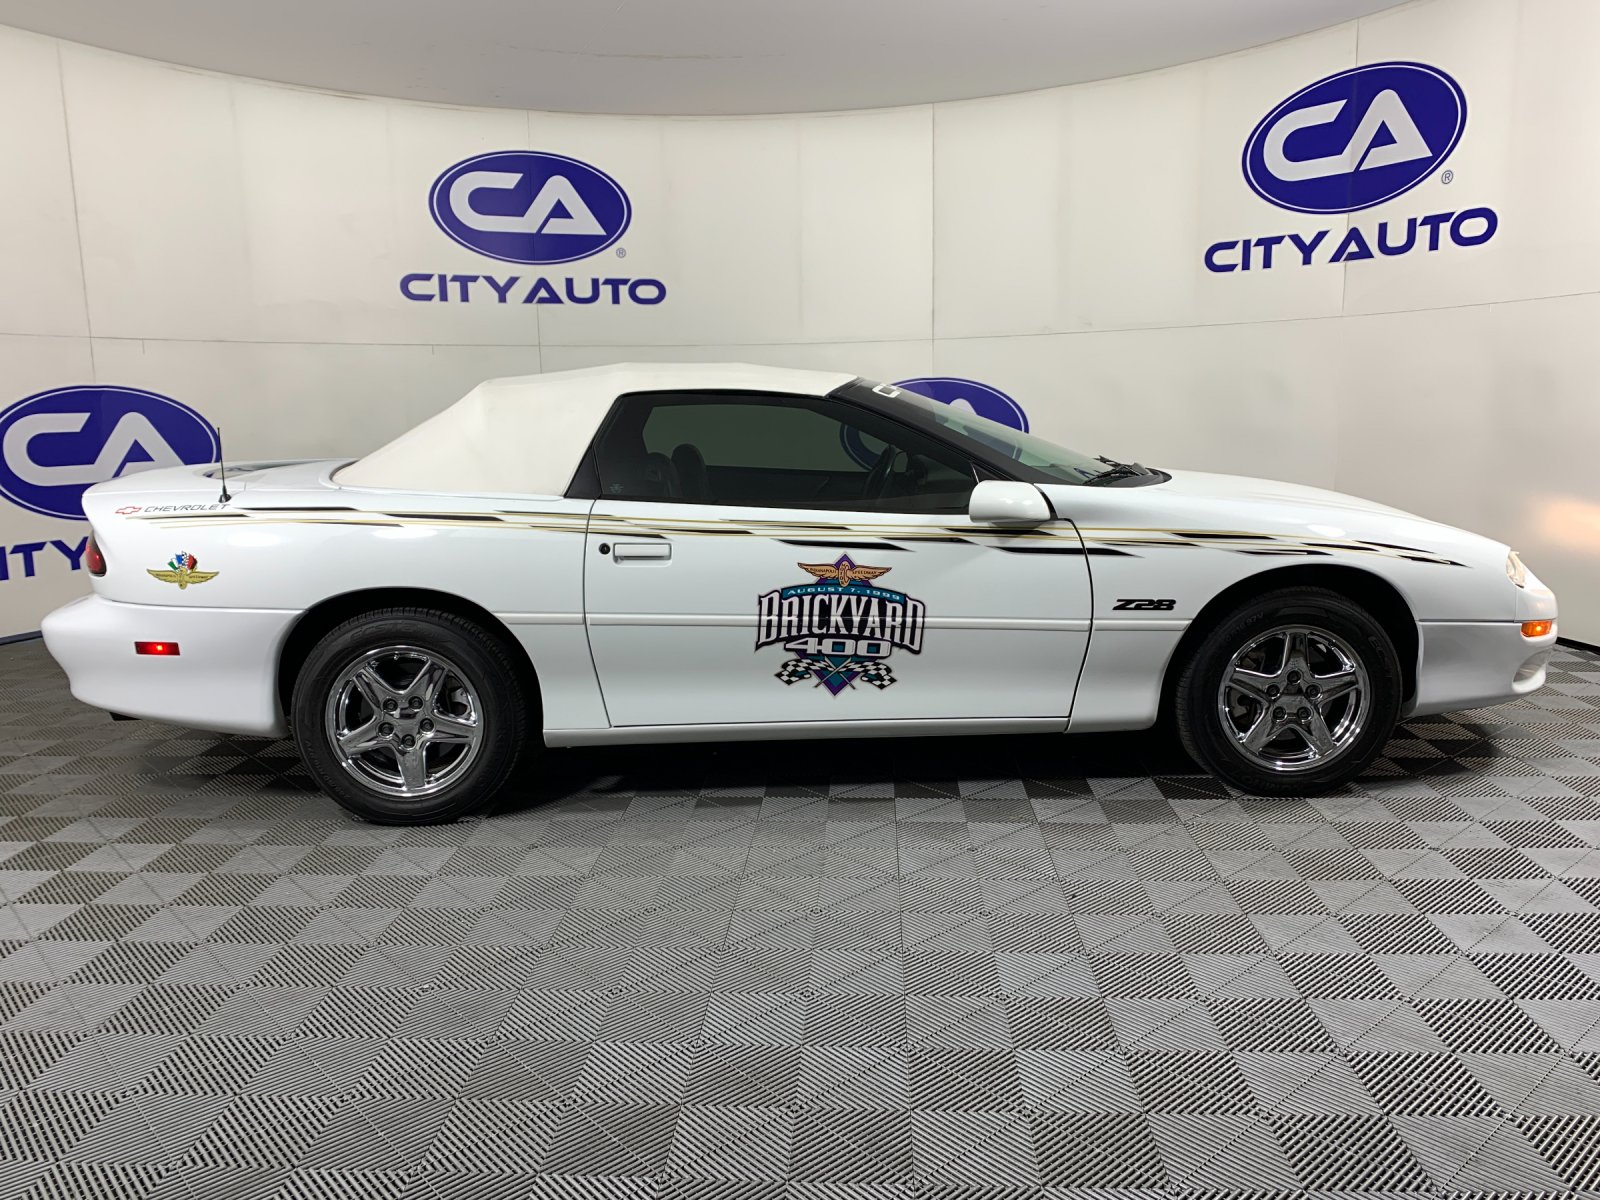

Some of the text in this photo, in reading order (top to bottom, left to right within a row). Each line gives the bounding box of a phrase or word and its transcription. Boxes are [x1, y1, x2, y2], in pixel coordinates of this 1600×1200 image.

[1263, 89, 1433, 181] CA
[449, 171, 607, 235] CA
[1204, 207, 1498, 272] CITY AUTO
[400, 273, 667, 305] CITY AUTO
[3, 411, 186, 487] CA
[144, 504, 230, 512] CHEVROLET
[787, 587, 844, 596] AUGUST
[866, 589, 900, 601] 1999
[1112, 599, 1176, 611] Z28
[756, 590, 925, 654] BRICKYARD
[785, 636, 891, 656] 400
